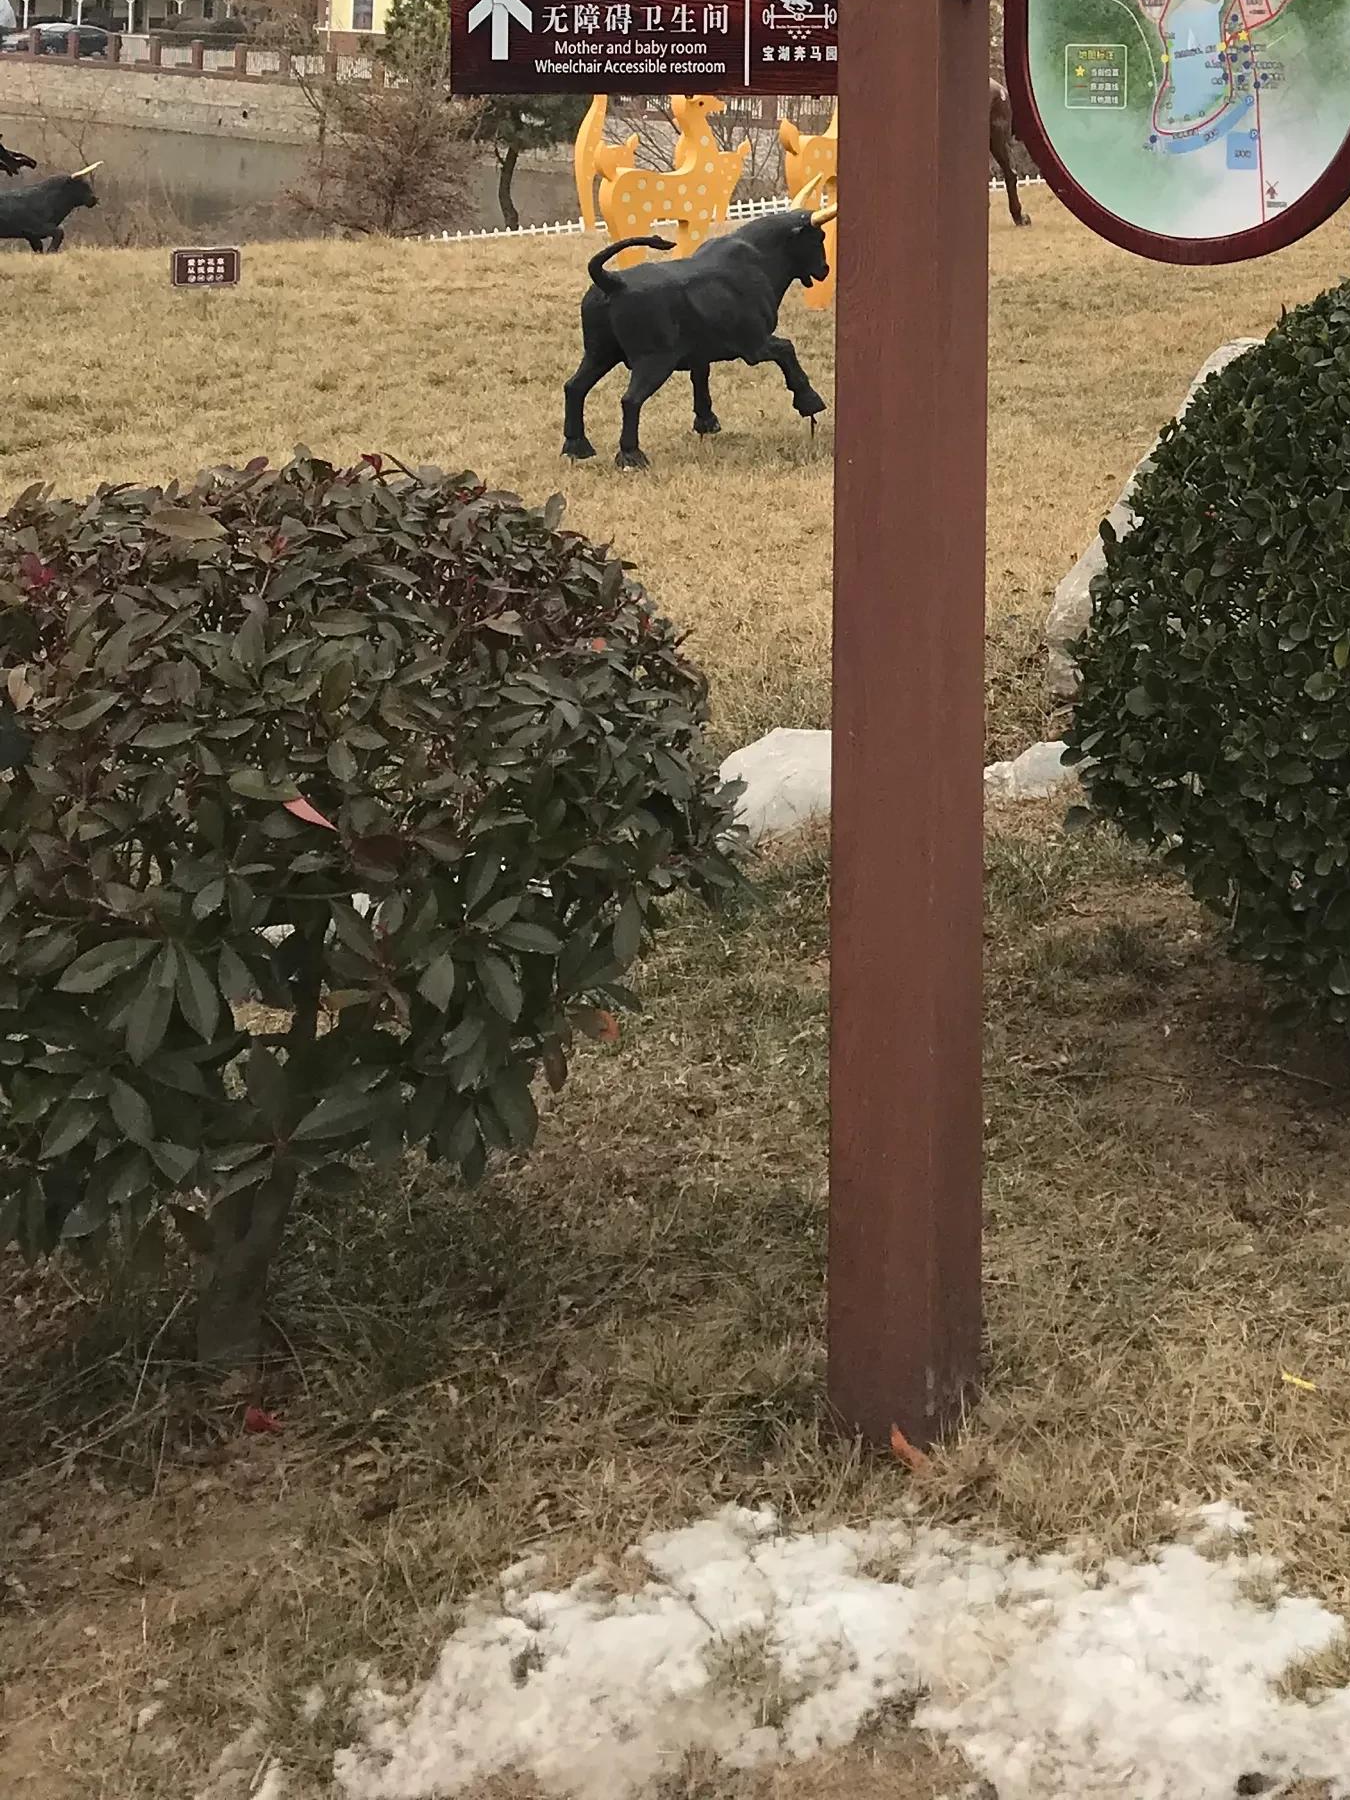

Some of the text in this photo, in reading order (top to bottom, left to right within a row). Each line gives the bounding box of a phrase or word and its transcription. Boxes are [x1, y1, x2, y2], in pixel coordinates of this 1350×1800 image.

[542, 3, 729, 35] 无障碍卫生间
[554, 40, 707, 58] Mother and baby room
[762, 45, 838, 62] 宝湖奔马园
[535, 59, 726, 74] Wheelchair Accessible restroom
